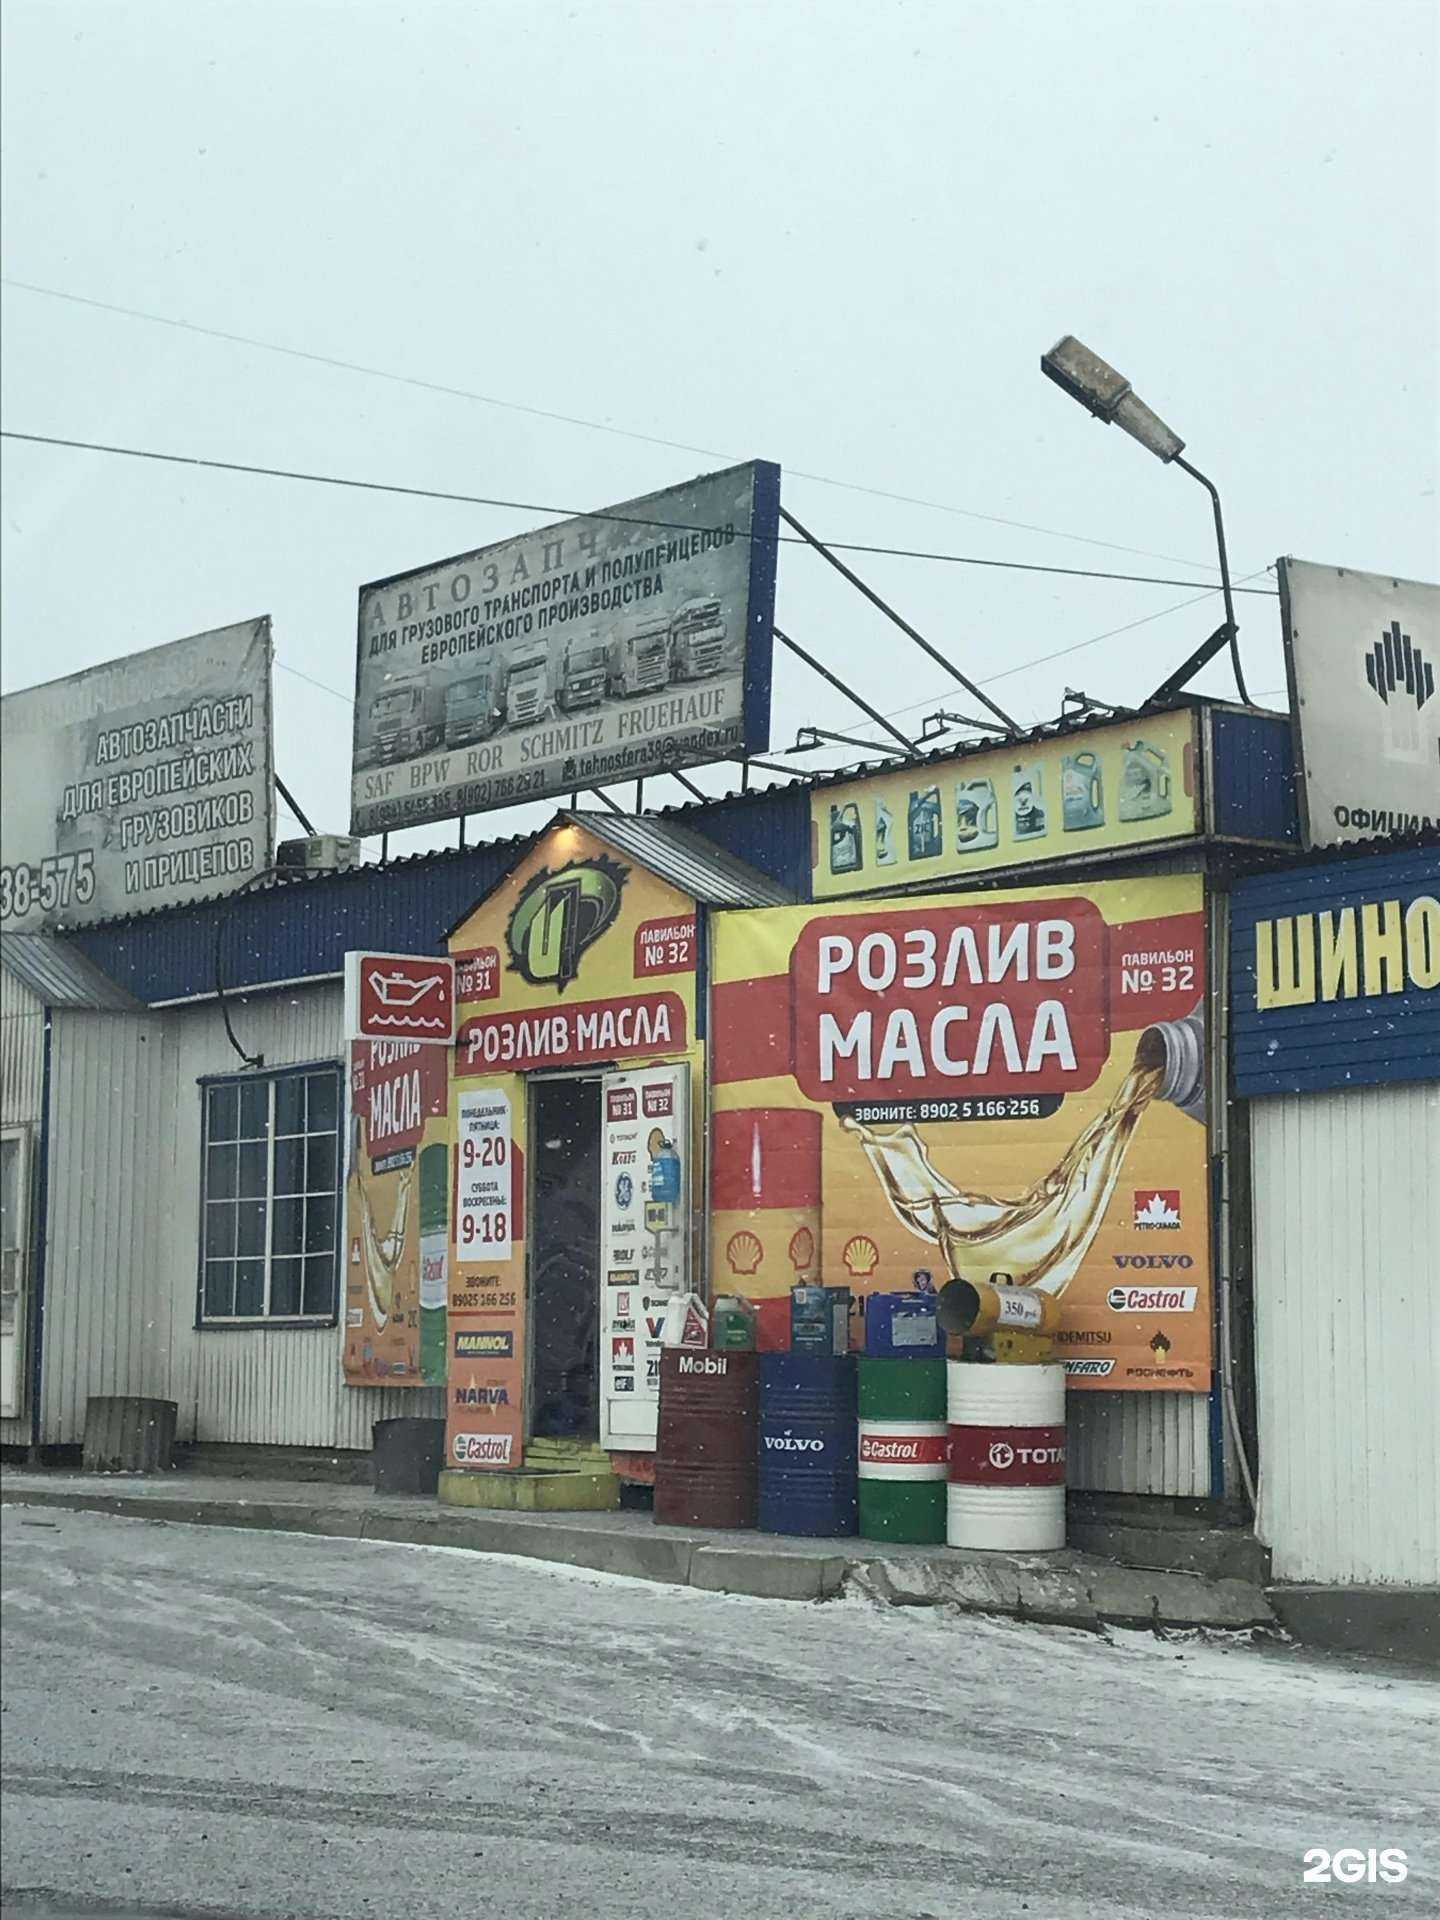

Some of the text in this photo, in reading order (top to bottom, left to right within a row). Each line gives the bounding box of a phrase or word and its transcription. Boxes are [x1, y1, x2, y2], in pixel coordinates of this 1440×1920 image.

[369, 523, 735, 658] ДЛЯ ГРУЗОВОГО ТРАНСПОРТА И ПОЛУПРИЦЕПОВ
[421, 573, 663, 664] ЕВРОПЕЙСКОГО ПРОИЗВОДСТВА
[96, 695, 252, 766] АВТОЗАПЧАСТИ
[364, 688, 726, 799] SAF BPW ROR SCHMITZ FRUEHAUF
[62, 743, 253, 821] ДЛЯ ЕВРОПЕЙСКИХ
[121, 791, 252, 849] ГРУЗОВИКОВ
[1334, 805, 1440, 832] ОФИЦИА
[125, 838, 252, 893] И ПРИЦЕПОВ
[640, 924, 696, 944] ПАВИЛЬОН
[645, 941, 688, 967] № 32
[817, 919, 1076, 994] РОЗЛИВ
[1121, 949, 1194, 966] ПАВИЛЬОН
[1256, 895, 1440, 1011] ШИНО
[456, 971, 491, 994] № 31
[1121, 965, 1194, 994] № 32
[467, 1017, 569, 1063] РОЗЛИВ
[577, 1003, 671, 1051] МАСЛА
[819, 1000, 1078, 1082] МАСЛА
[369, 1069, 420, 1141] МАСЛА
[855, 1106, 917, 1121] ЗВОНИТЕ:
[920, 1103, 958, 1119] 8902
[962, 1102, 972, 1117] 5
[463, 1136, 506, 1169] 9-20
[463, 1212, 506, 1244] 9-18
[1112, 1254, 1193, 1269] VOLVO
[1005, 1301, 1023, 1317] 350
[1127, 1290, 1186, 1309] Castrol
[457, 1336, 510, 1350] MANNOL
[647, 1360, 659, 1377] ZI
[679, 1356, 727, 1375] Mobil
[1126, 1367, 1194, 1378] РОСНЕФТЬ
[456, 1387, 510, 1405] NARVA
[467, 1438, 508, 1460] Castrol
[764, 1437, 825, 1452] VOLVO
[871, 1441, 917, 1458] Castrol
[1017, 1447, 1066, 1464] TOTA
